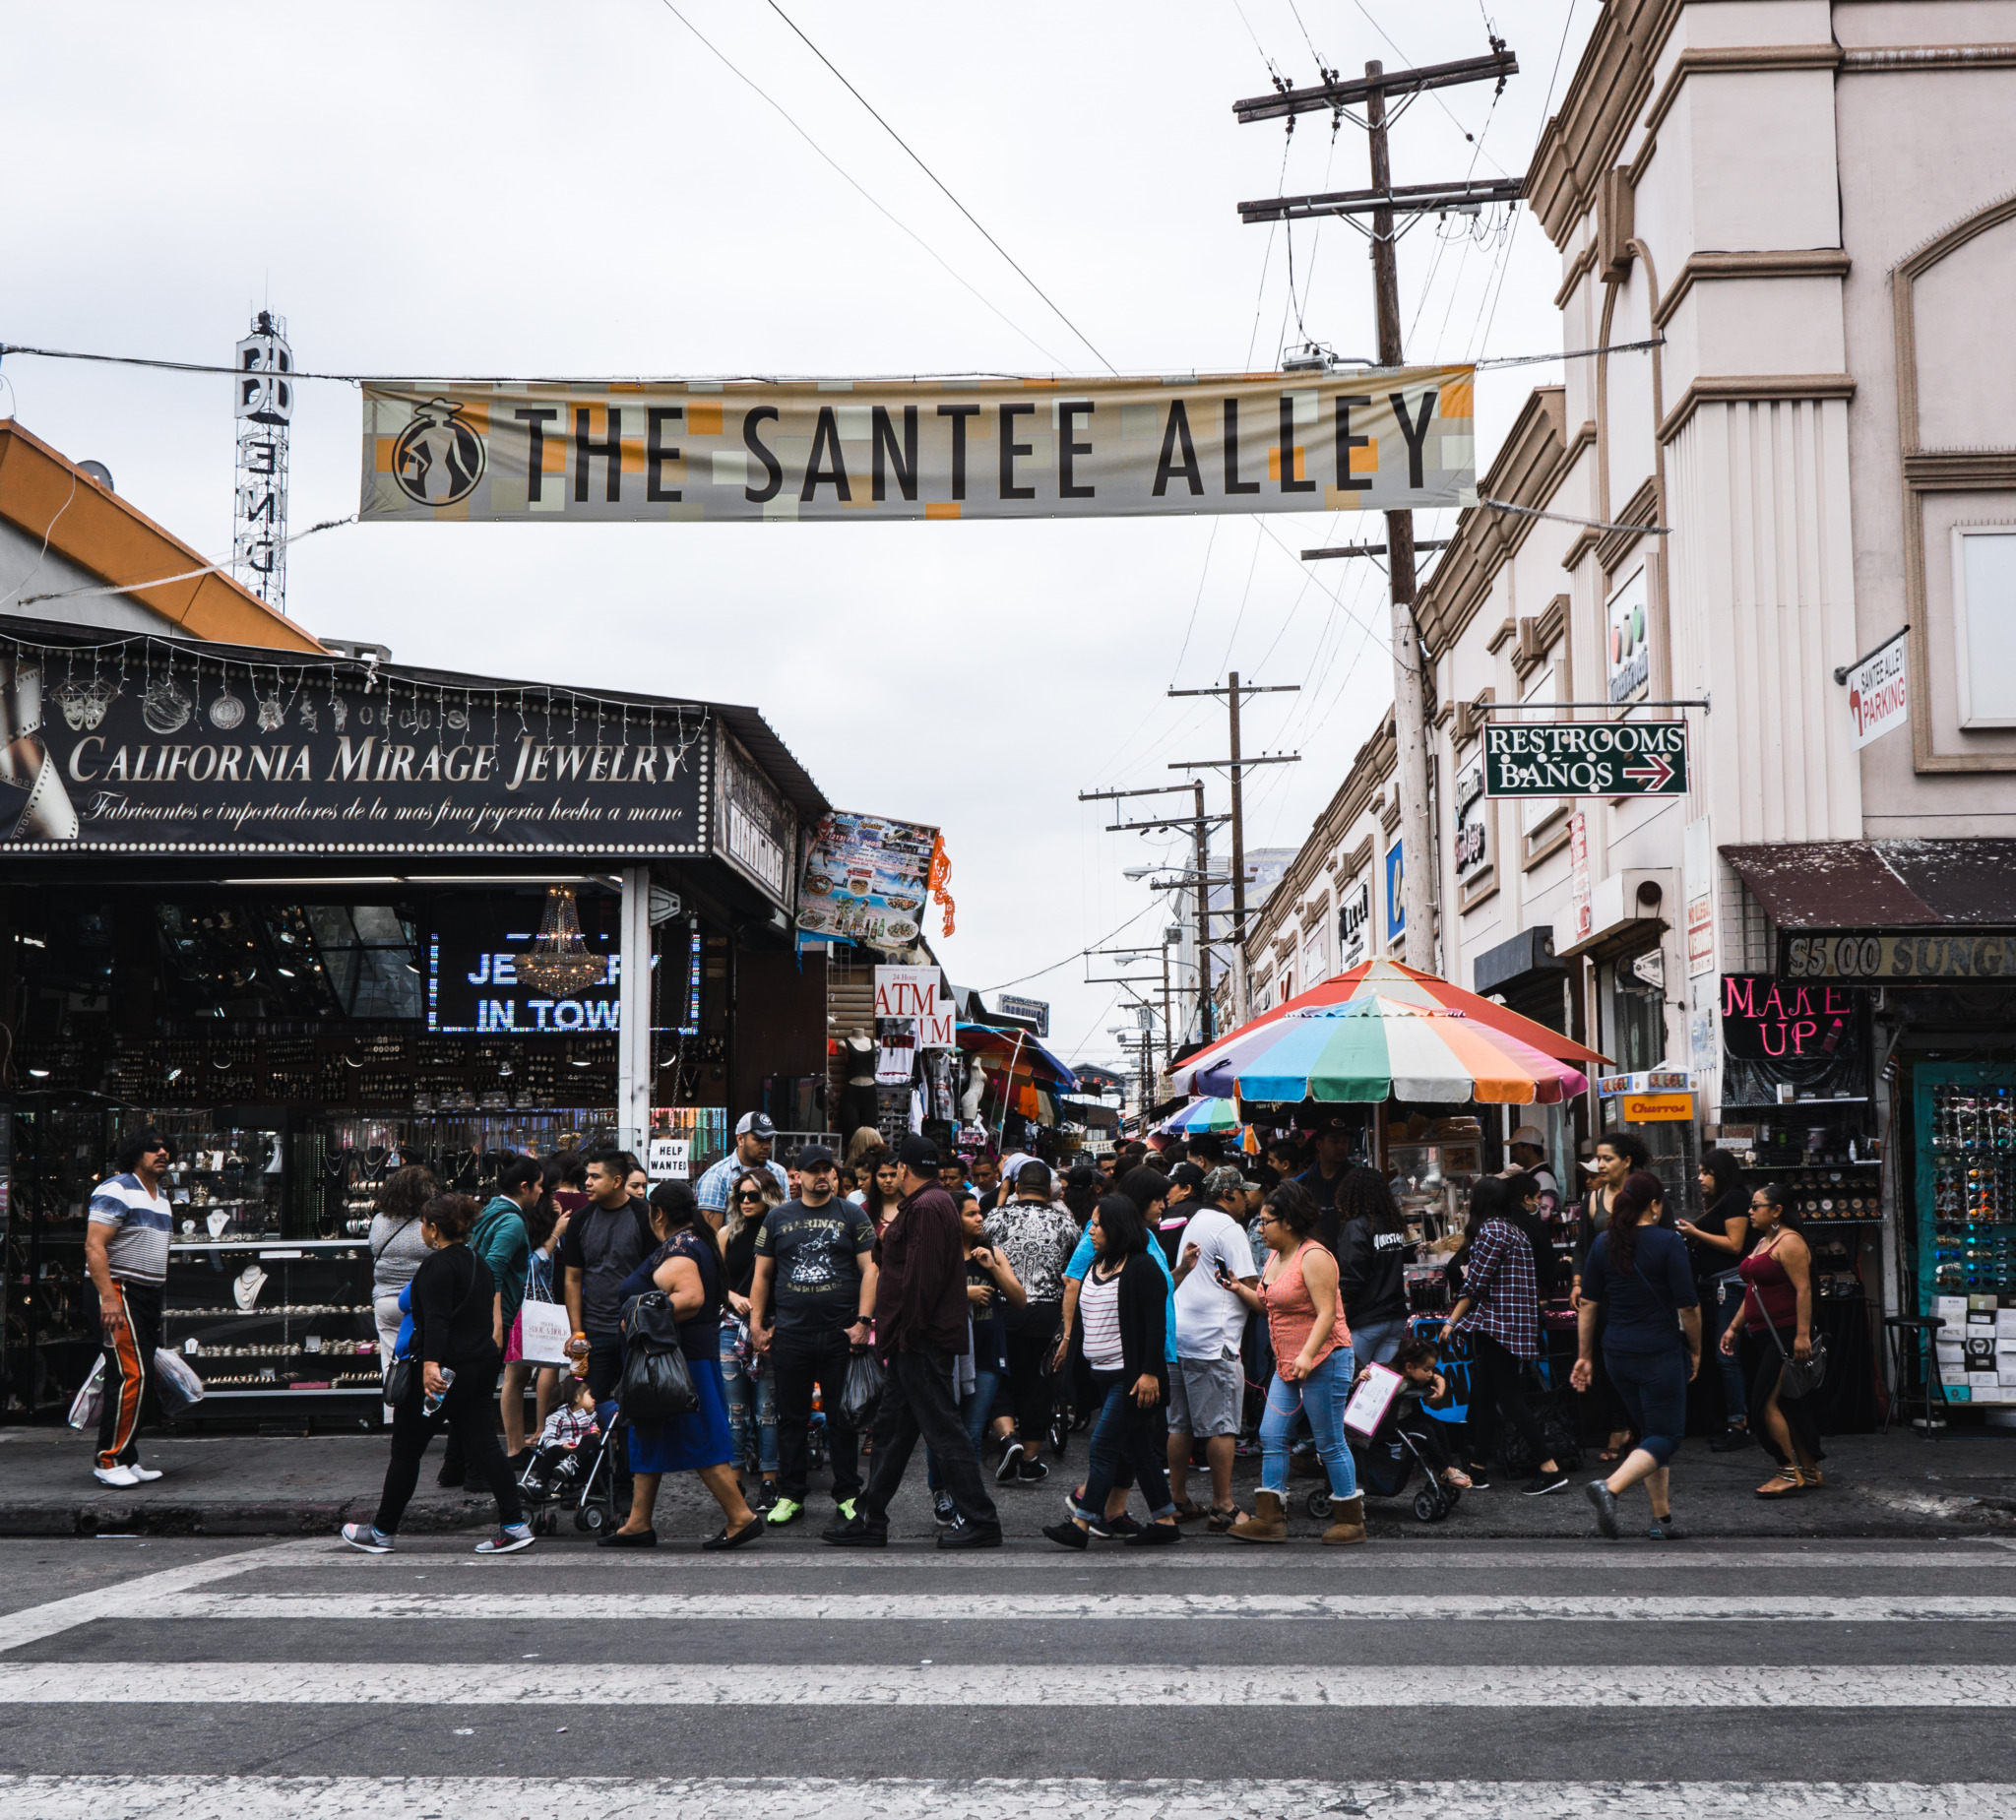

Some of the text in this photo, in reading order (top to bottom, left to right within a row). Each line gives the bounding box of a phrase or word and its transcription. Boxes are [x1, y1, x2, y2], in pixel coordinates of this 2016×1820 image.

[514, 391, 1441, 504] THE SANTEE ALLEY
[1861, 646, 1904, 695] SANTEE ALLEY
[1863, 677, 1905, 728] PARKING
[1488, 727, 1683, 754] RESTROOMS
[69, 735, 689, 790] CALIFORNIA MIRAGE JEWELRY
[1499, 757, 1613, 788] BAÑOS
[83, 789, 685, 834] Fabricantes e importadores de la mas fina joyeria hecha a mano
[837, 814, 858, 829] Baby
[1789, 937, 1881, 976] $5.00
[477, 1000, 621, 1028] IN TOW
[875, 982, 936, 1016] ATM
[1723, 977, 1850, 1020] MAKE
[1759, 1021, 1817, 1055] UP
[1631, 1102, 1685, 1113] Churros
[651, 1161, 686, 1170] WANTED
[660, 1146, 683, 1156] HELP
